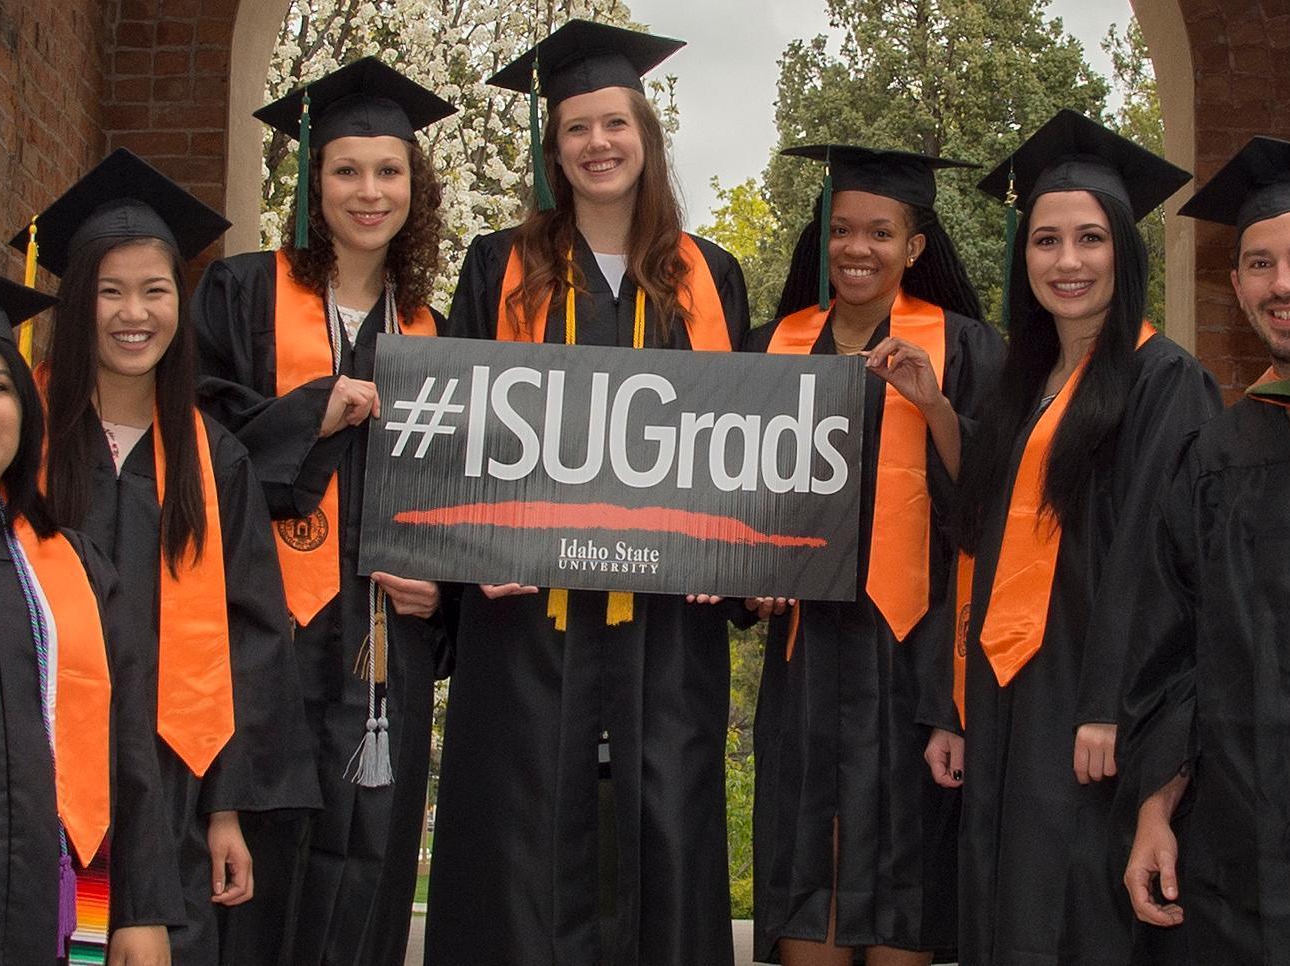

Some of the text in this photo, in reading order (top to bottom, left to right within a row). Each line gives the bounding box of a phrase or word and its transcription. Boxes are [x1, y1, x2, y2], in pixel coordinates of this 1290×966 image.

[384, 365, 849, 494] #ISUGrads
[559, 538, 659, 562] Idaho State
[558, 560, 659, 574] UNIVERSITY
